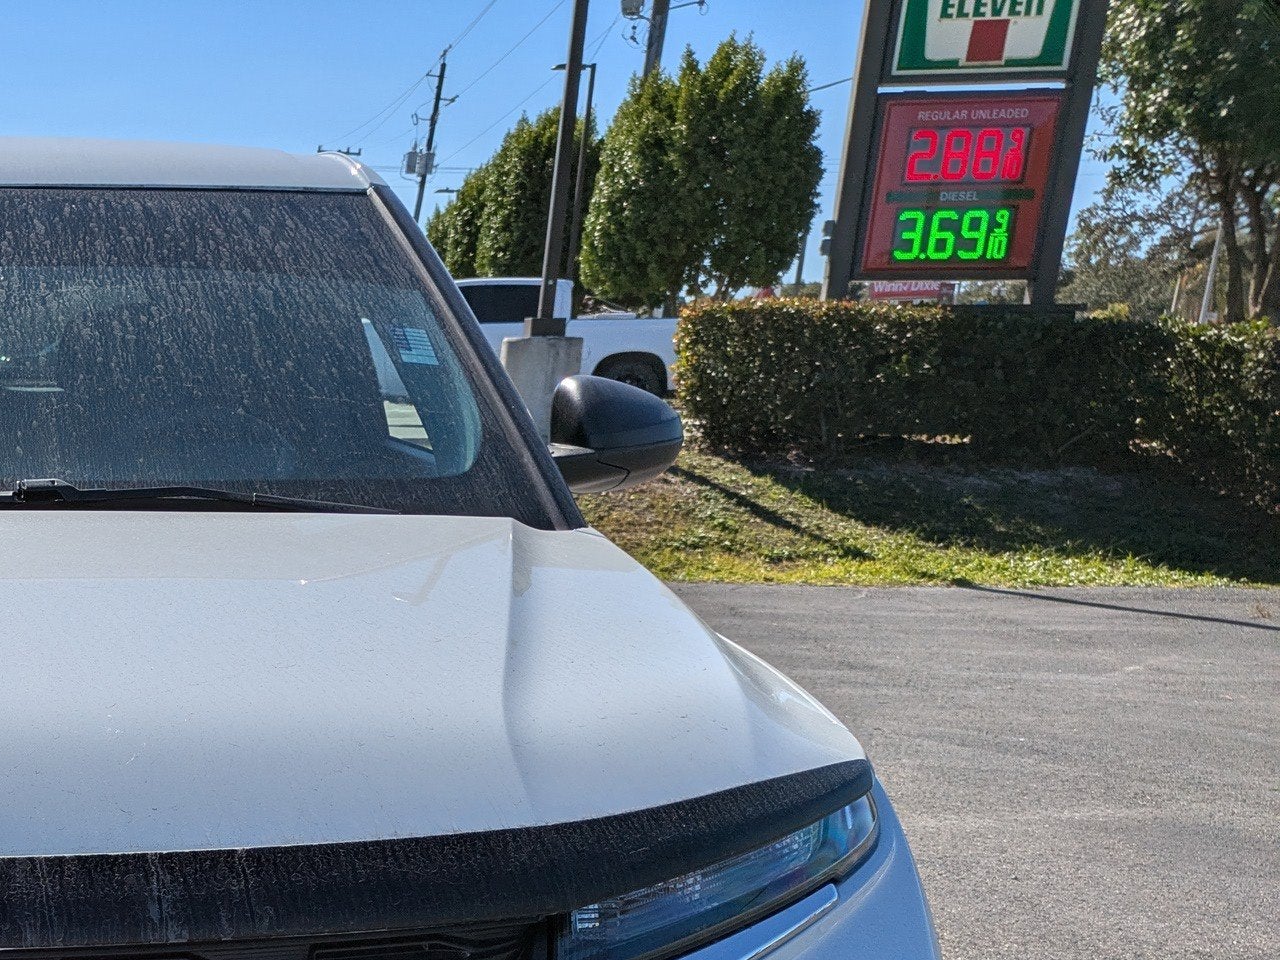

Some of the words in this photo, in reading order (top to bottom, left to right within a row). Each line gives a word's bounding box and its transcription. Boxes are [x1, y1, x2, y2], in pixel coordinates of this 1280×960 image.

[918, 110, 968, 121] REGULAR
[970, 108, 1029, 119] UNLEADED
[906, 128, 1004, 181] 2.88
[940, 190, 979, 202] DIESEL
[893, 210, 989, 260] 3.69
